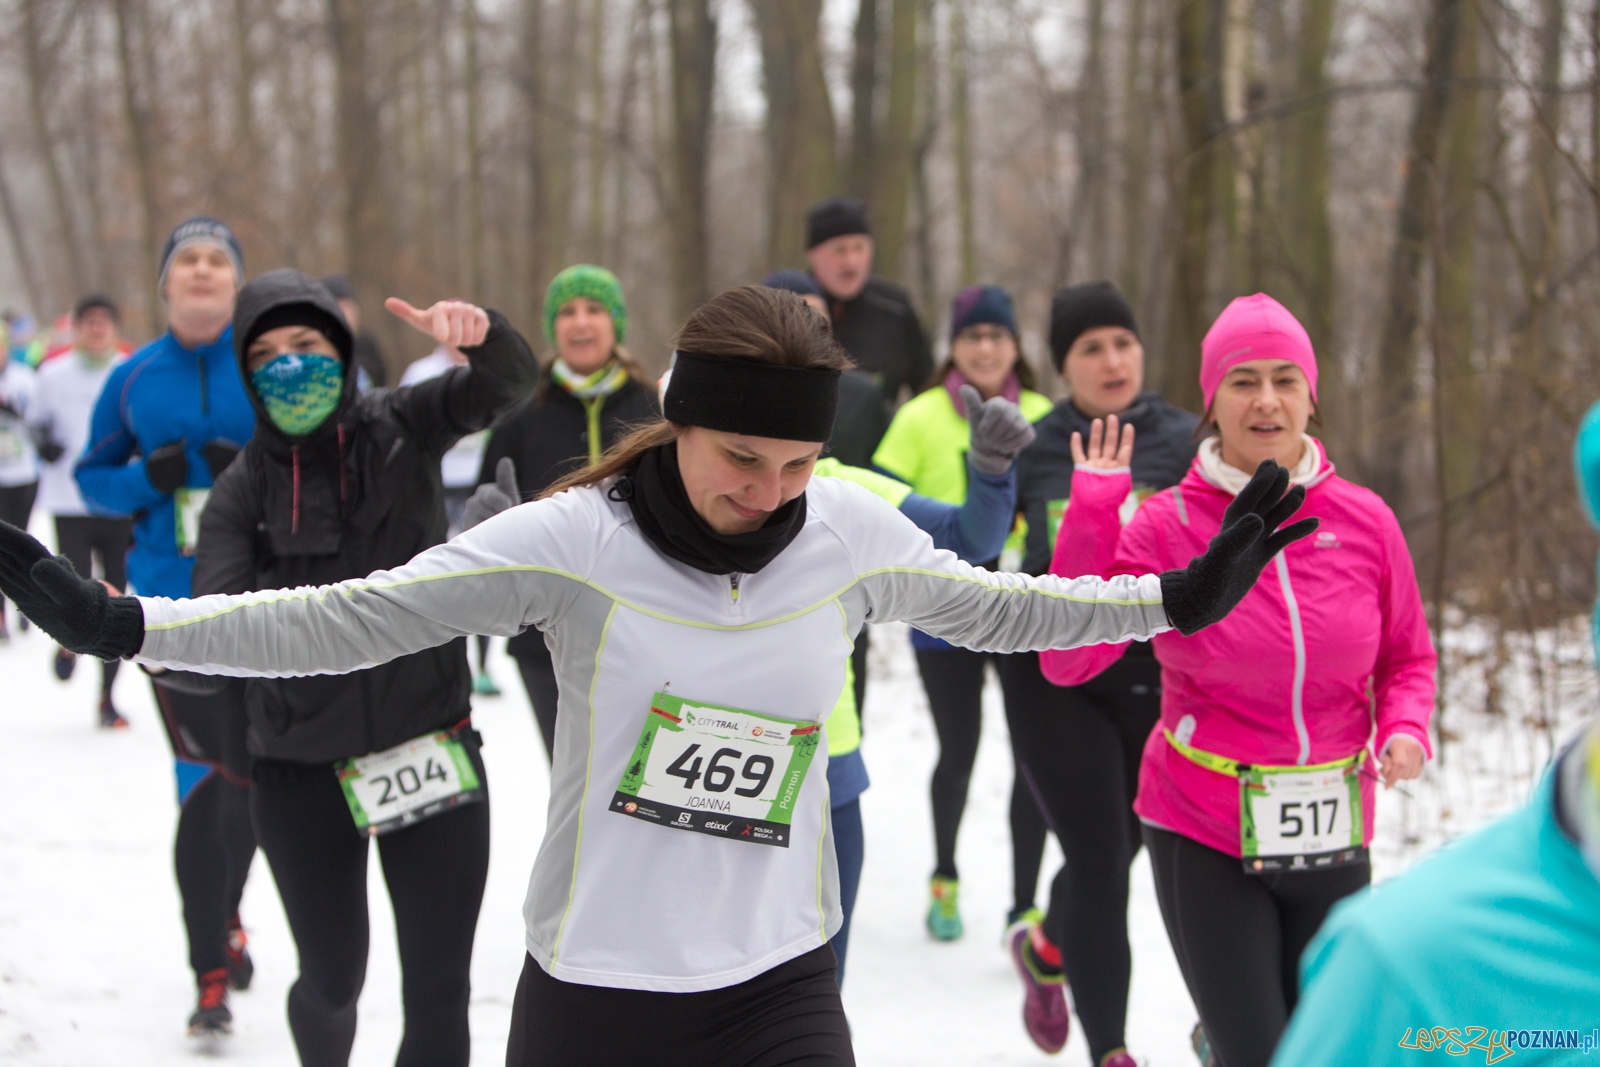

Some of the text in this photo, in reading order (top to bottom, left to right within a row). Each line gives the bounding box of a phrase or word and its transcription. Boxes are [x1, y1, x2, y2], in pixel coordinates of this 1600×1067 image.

[367, 756, 448, 807] 204
[666, 743, 774, 798] 469
[779, 770, 801, 809] Poznań
[684, 795, 731, 812] JOANNA
[1279, 798, 1339, 838] 517
